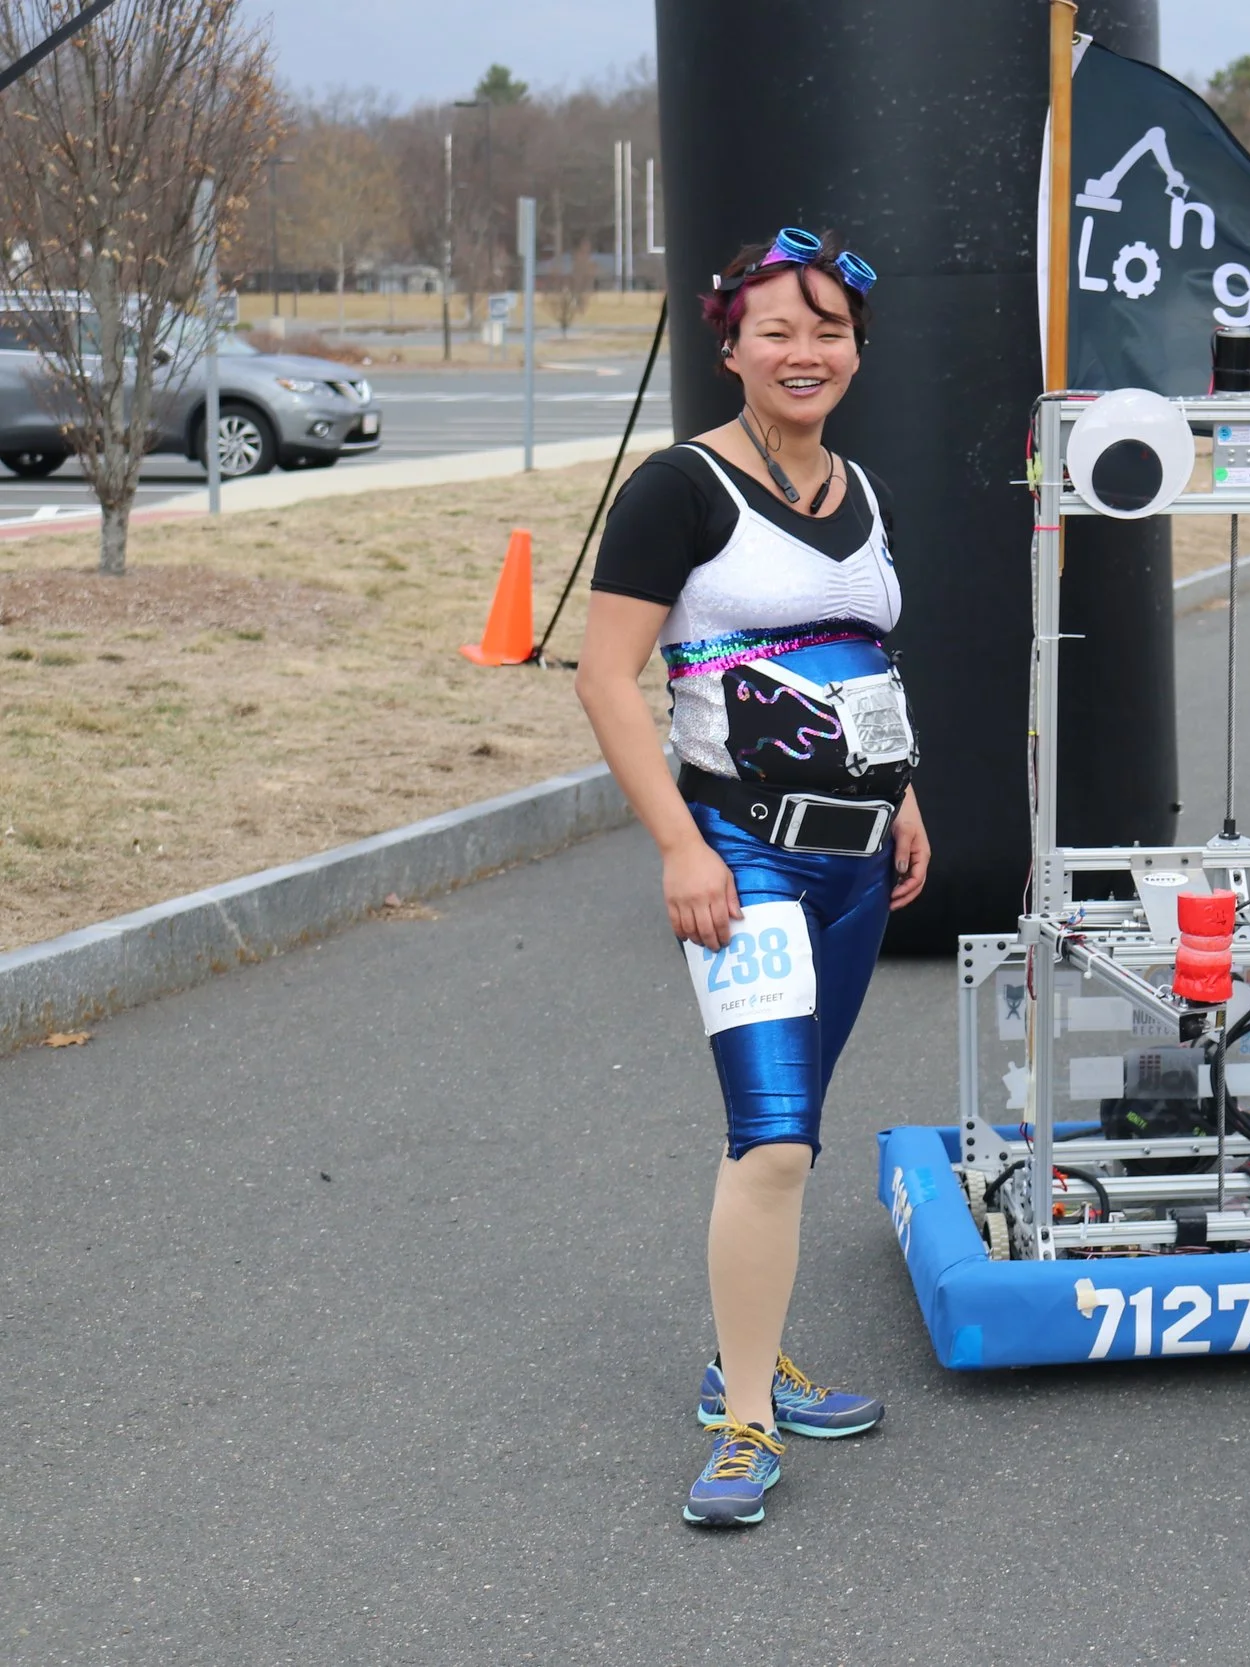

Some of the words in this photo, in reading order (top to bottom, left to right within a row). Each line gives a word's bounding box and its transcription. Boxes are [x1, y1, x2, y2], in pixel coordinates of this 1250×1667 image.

[702, 927, 792, 993] 238
[721, 998, 747, 1012] FLEET
[760, 992, 784, 1003] FEET
